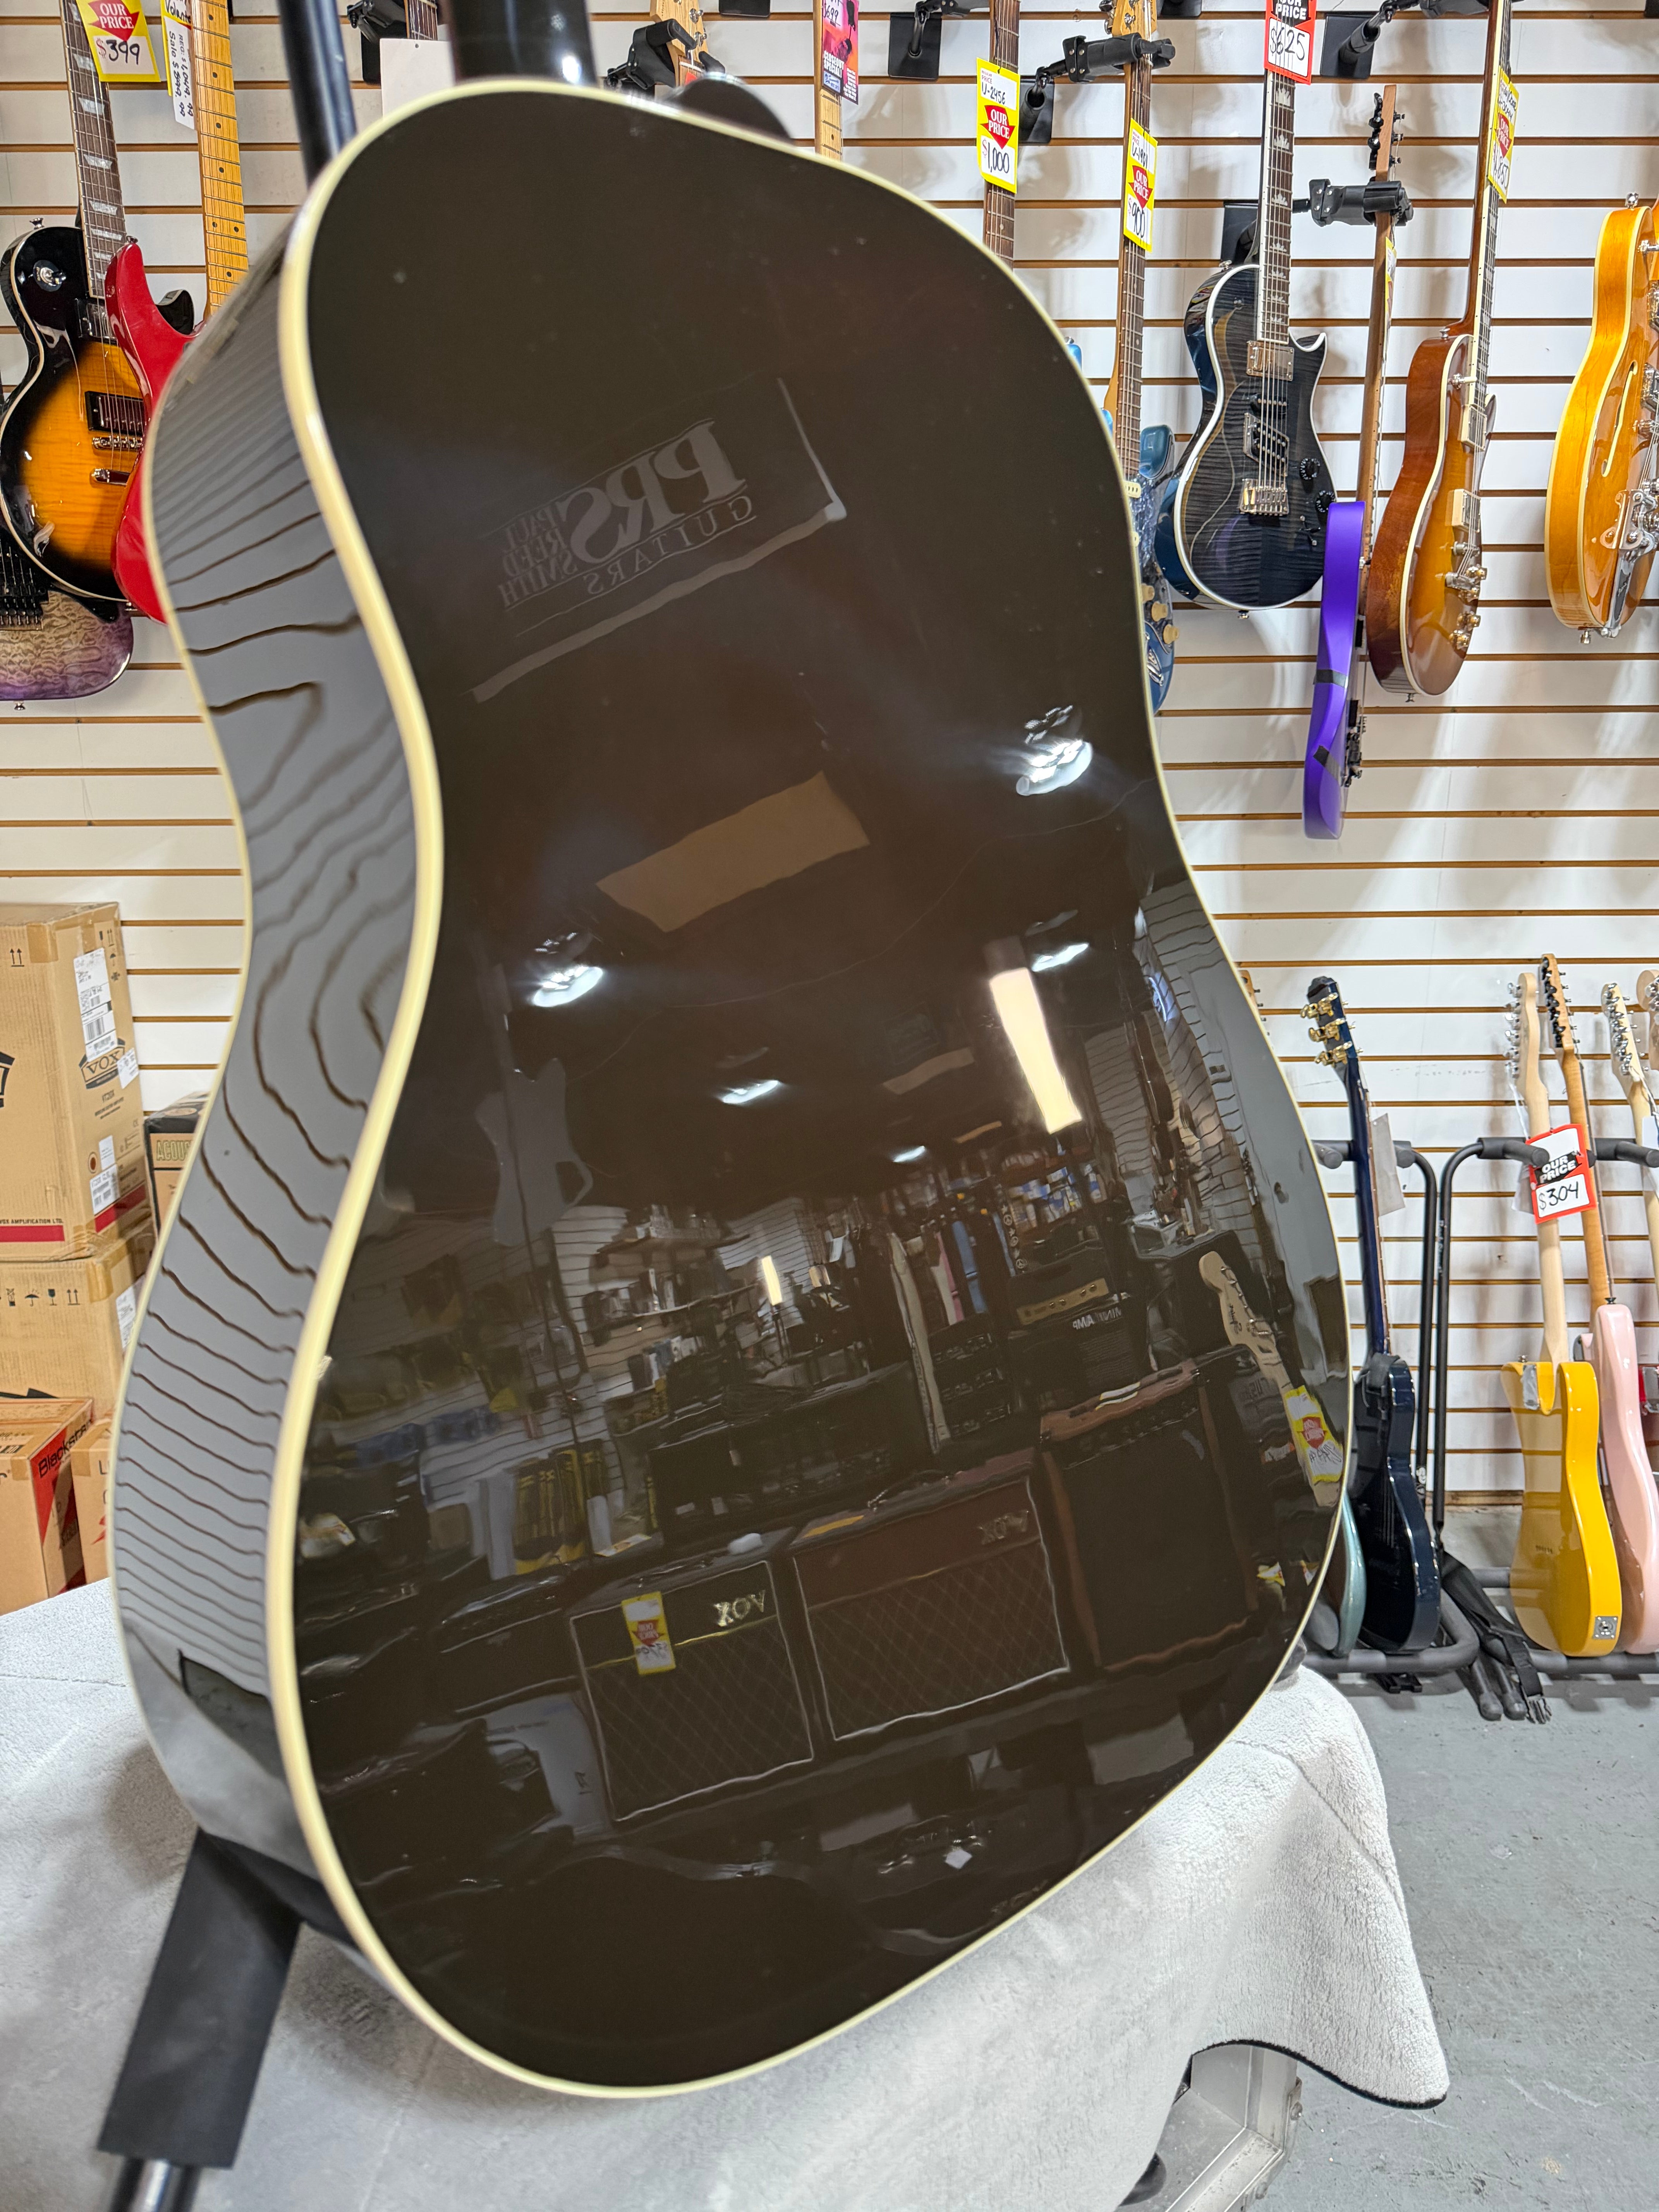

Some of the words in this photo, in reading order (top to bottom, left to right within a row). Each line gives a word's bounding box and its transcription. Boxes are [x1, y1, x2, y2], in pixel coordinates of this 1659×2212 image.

[100, 3, 127, 16] OUR
[1276, 3, 1307, 20] PRICE
[98, 16, 134, 29] PRICE
[96, 37, 140, 65] $399
[1270, 26, 1305, 61] $625
[824, 50, 844, 70] CLOSEOUT
[824, 60, 842, 78] SPECIAL!
[982, 75, 992, 84] PRICE
[982, 82, 1005, 105] U-2456
[991, 109, 1007, 126] OUR
[1500, 118, 1509, 137] OUR
[988, 120, 1010, 139] PRICE
[1498, 127, 1509, 150] PRICE
[982, 138, 1009, 173] $1,000
[1136, 170, 1147, 188] OUR
[1133, 180, 1149, 201] PRICE
[1128, 198, 1145, 238] $900
[86, 1050, 120, 1074] VOX
[1539, 1160, 1576, 1183] PRICE
[1542, 1156, 1568, 1173] OUR
[1539, 1181, 1578, 1211] $304
[38, 1419, 94, 1478] Blackstar
